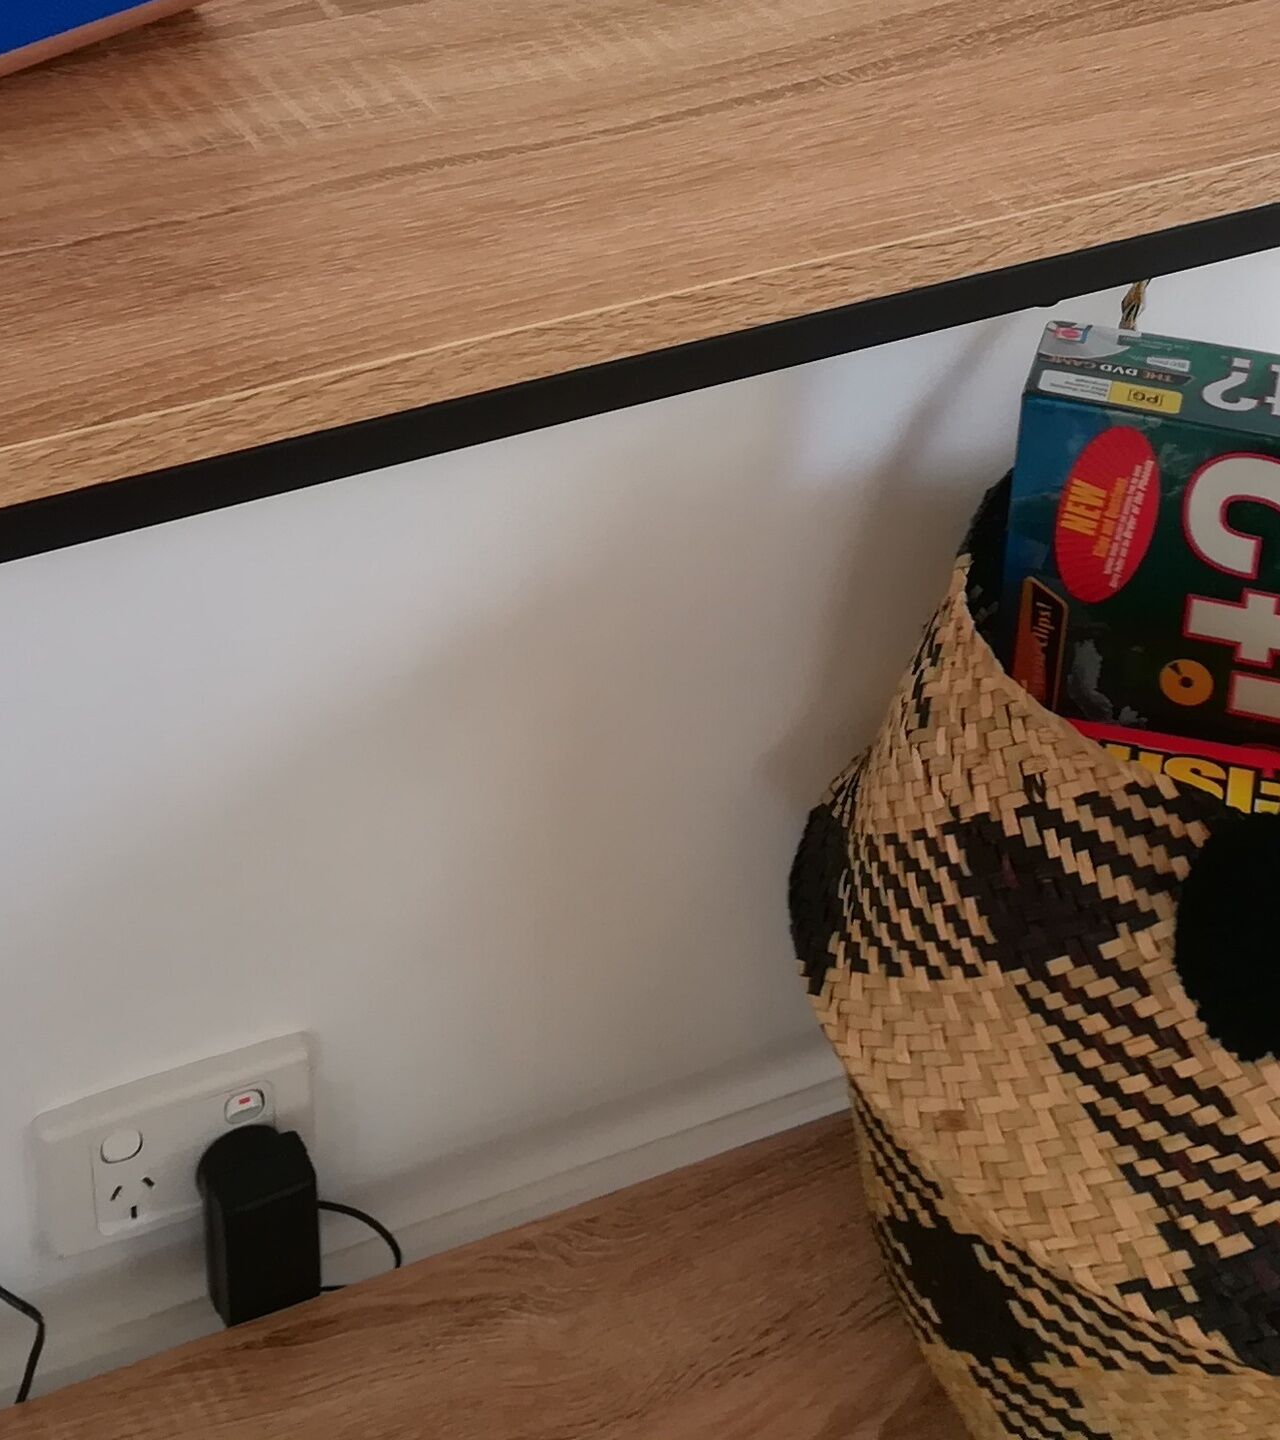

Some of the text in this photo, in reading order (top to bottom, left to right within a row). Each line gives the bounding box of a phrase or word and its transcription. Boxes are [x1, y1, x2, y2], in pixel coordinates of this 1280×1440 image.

[1100, 364, 1138, 377] DVD
[1133, 392, 1159, 404] PG
[1060, 477, 1107, 536] NEW
